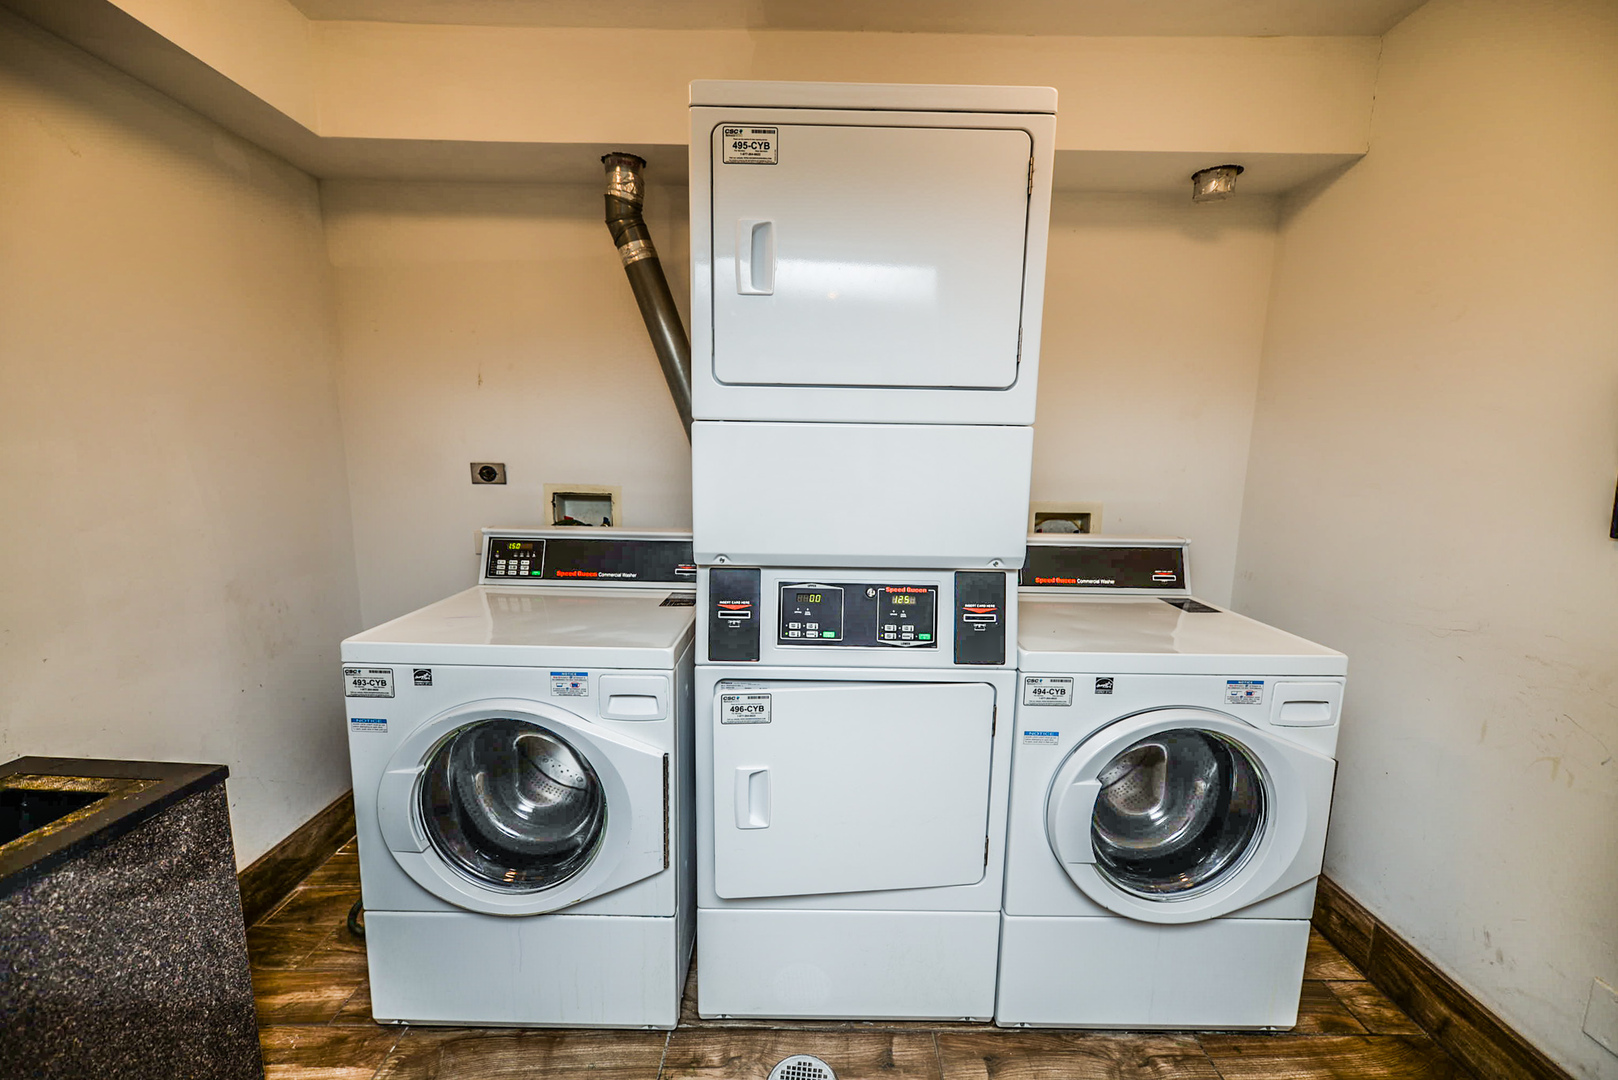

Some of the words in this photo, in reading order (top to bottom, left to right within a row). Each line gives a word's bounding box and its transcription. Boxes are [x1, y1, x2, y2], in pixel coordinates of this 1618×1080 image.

[732, 141, 771, 150] 495-CYB
[556, 570, 577, 578] Speed
[352, 679, 387, 687] 493-CYB
[730, 705, 765, 713] 496-CYB
